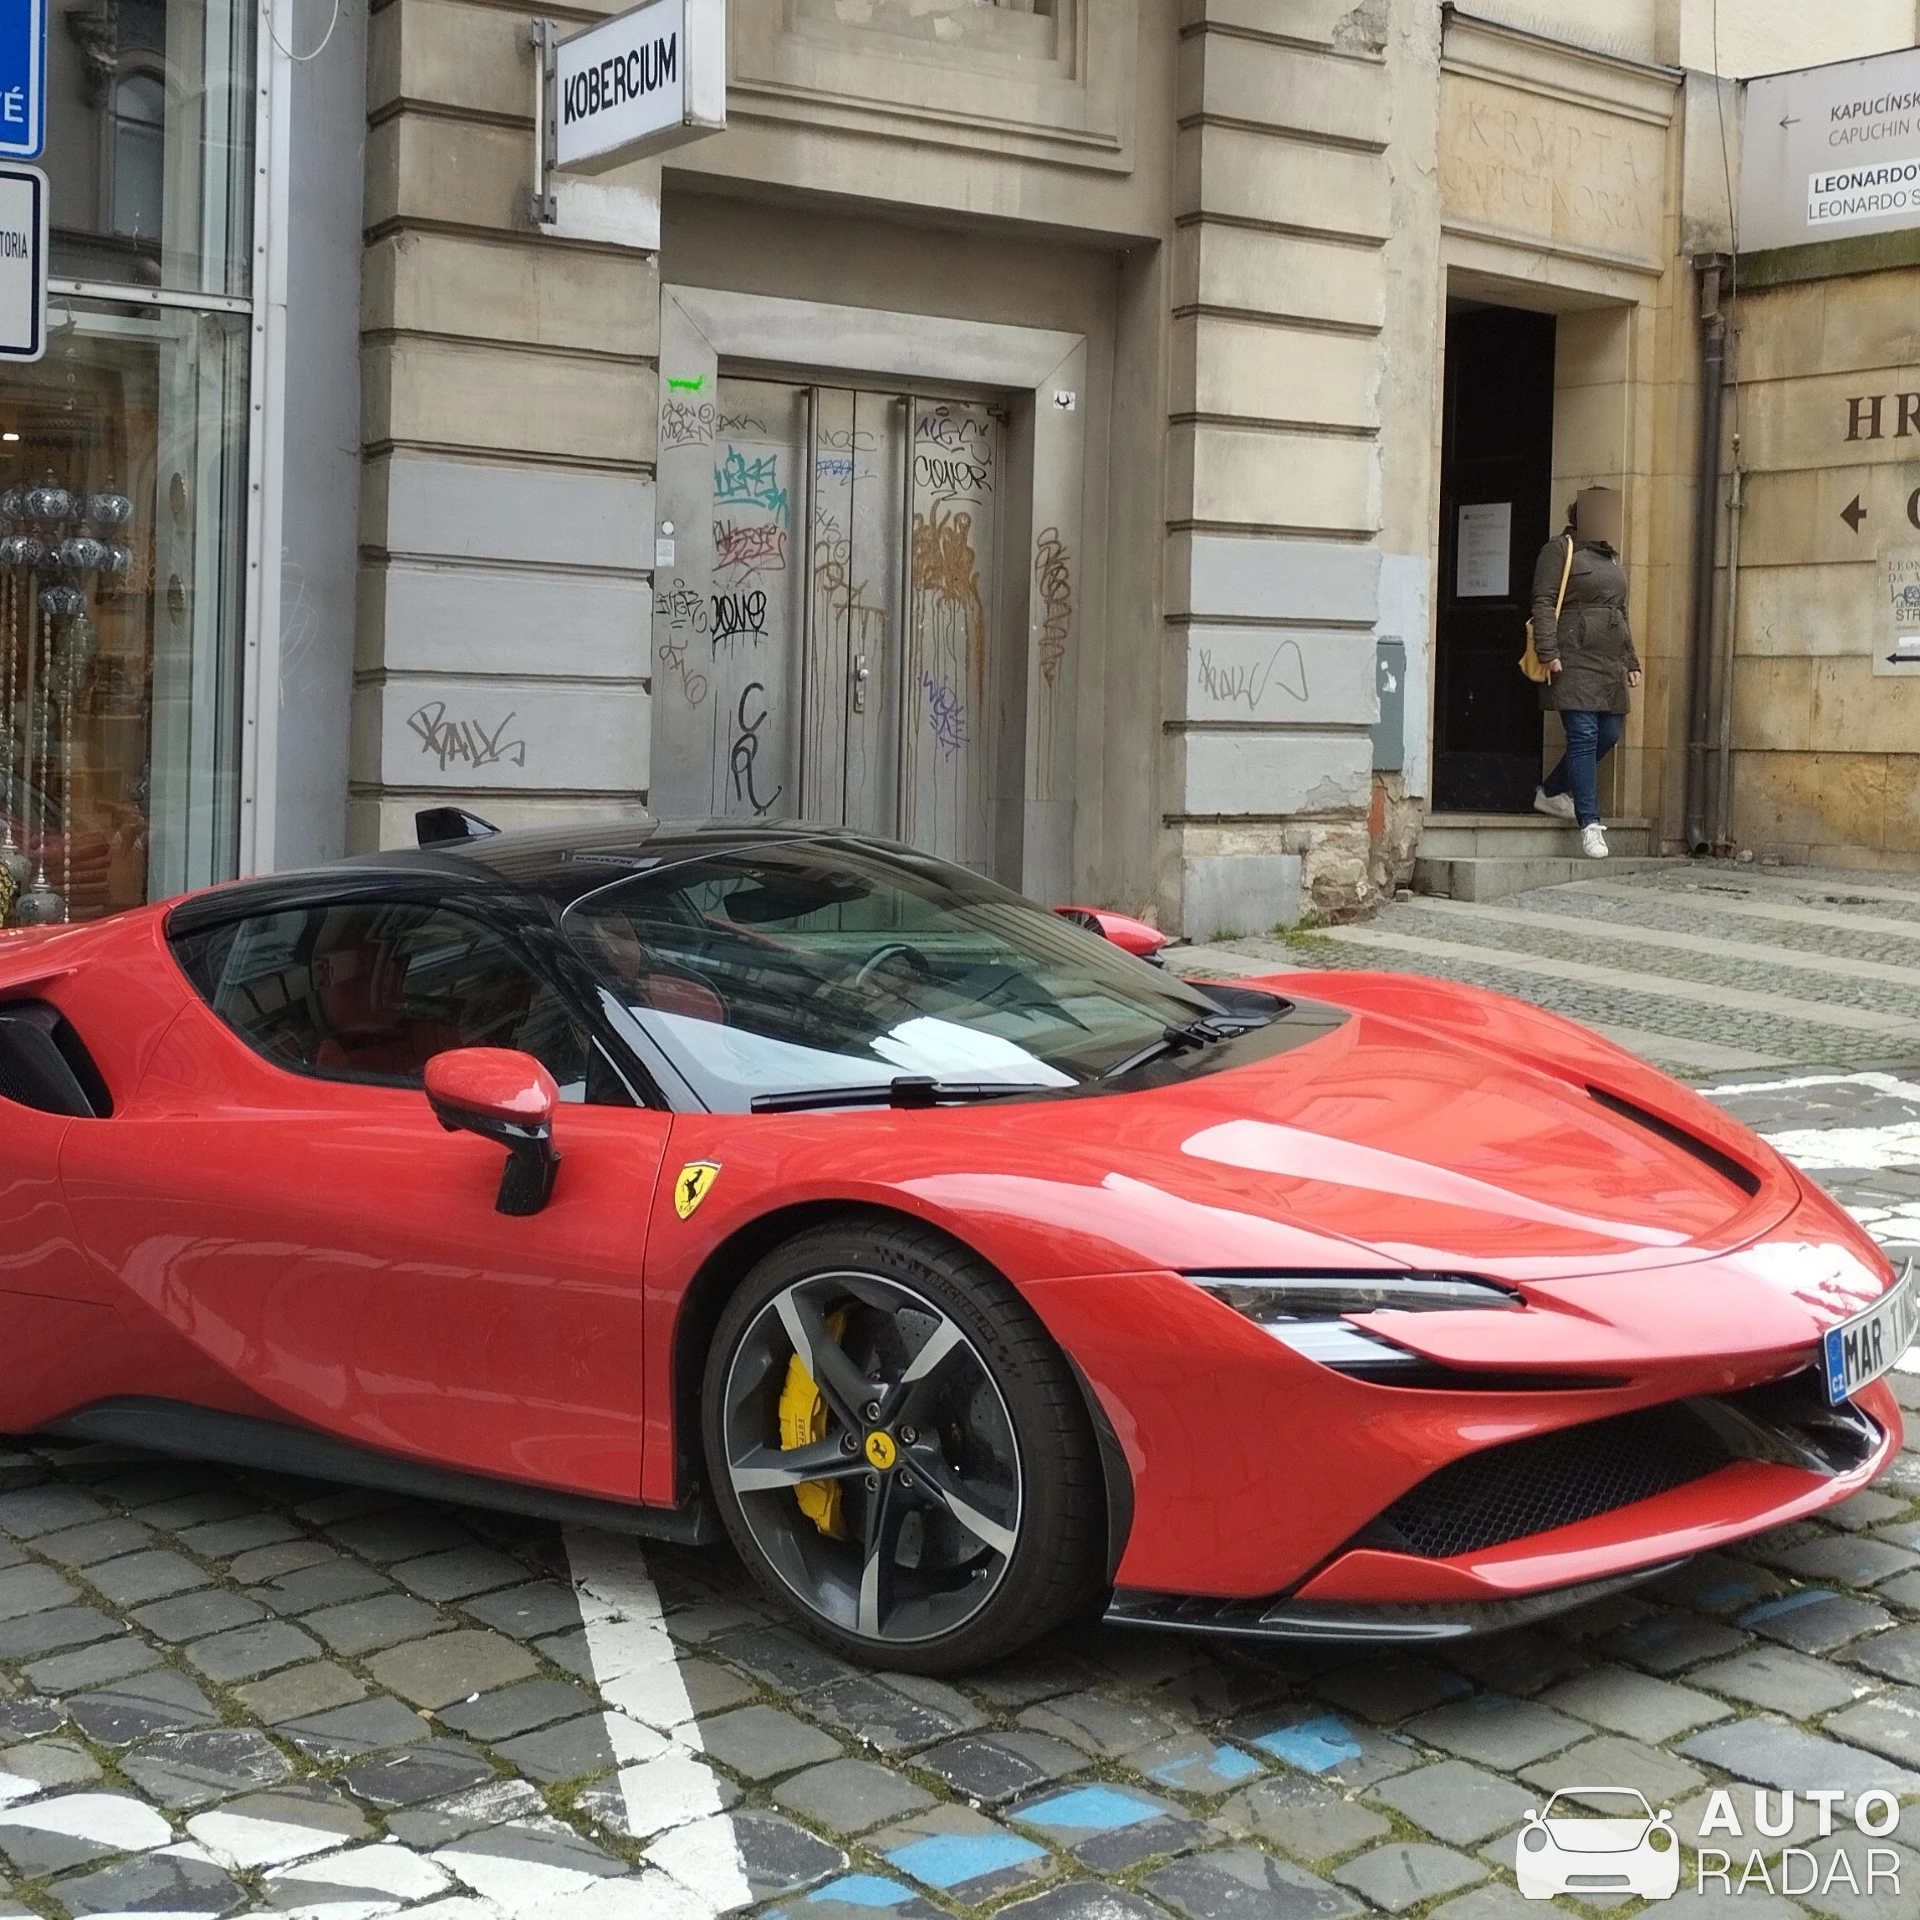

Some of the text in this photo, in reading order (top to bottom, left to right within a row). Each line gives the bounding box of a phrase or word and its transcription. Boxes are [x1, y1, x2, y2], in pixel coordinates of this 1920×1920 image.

[564, 31, 677, 126] KOBERCIUM
[0, 85, 24, 123] É
[1466, 101, 1641, 185] KRYPTA
[1828, 118, 1910, 147] CAPUCHIN
[1814, 163, 1920, 194] LEONARDO
[0, 231, 28, 259] TORIA
[1843, 392, 1920, 442] HR
[1832, 1373, 1845, 1393] CZ
[1844, 1316, 1884, 1388] MAR
